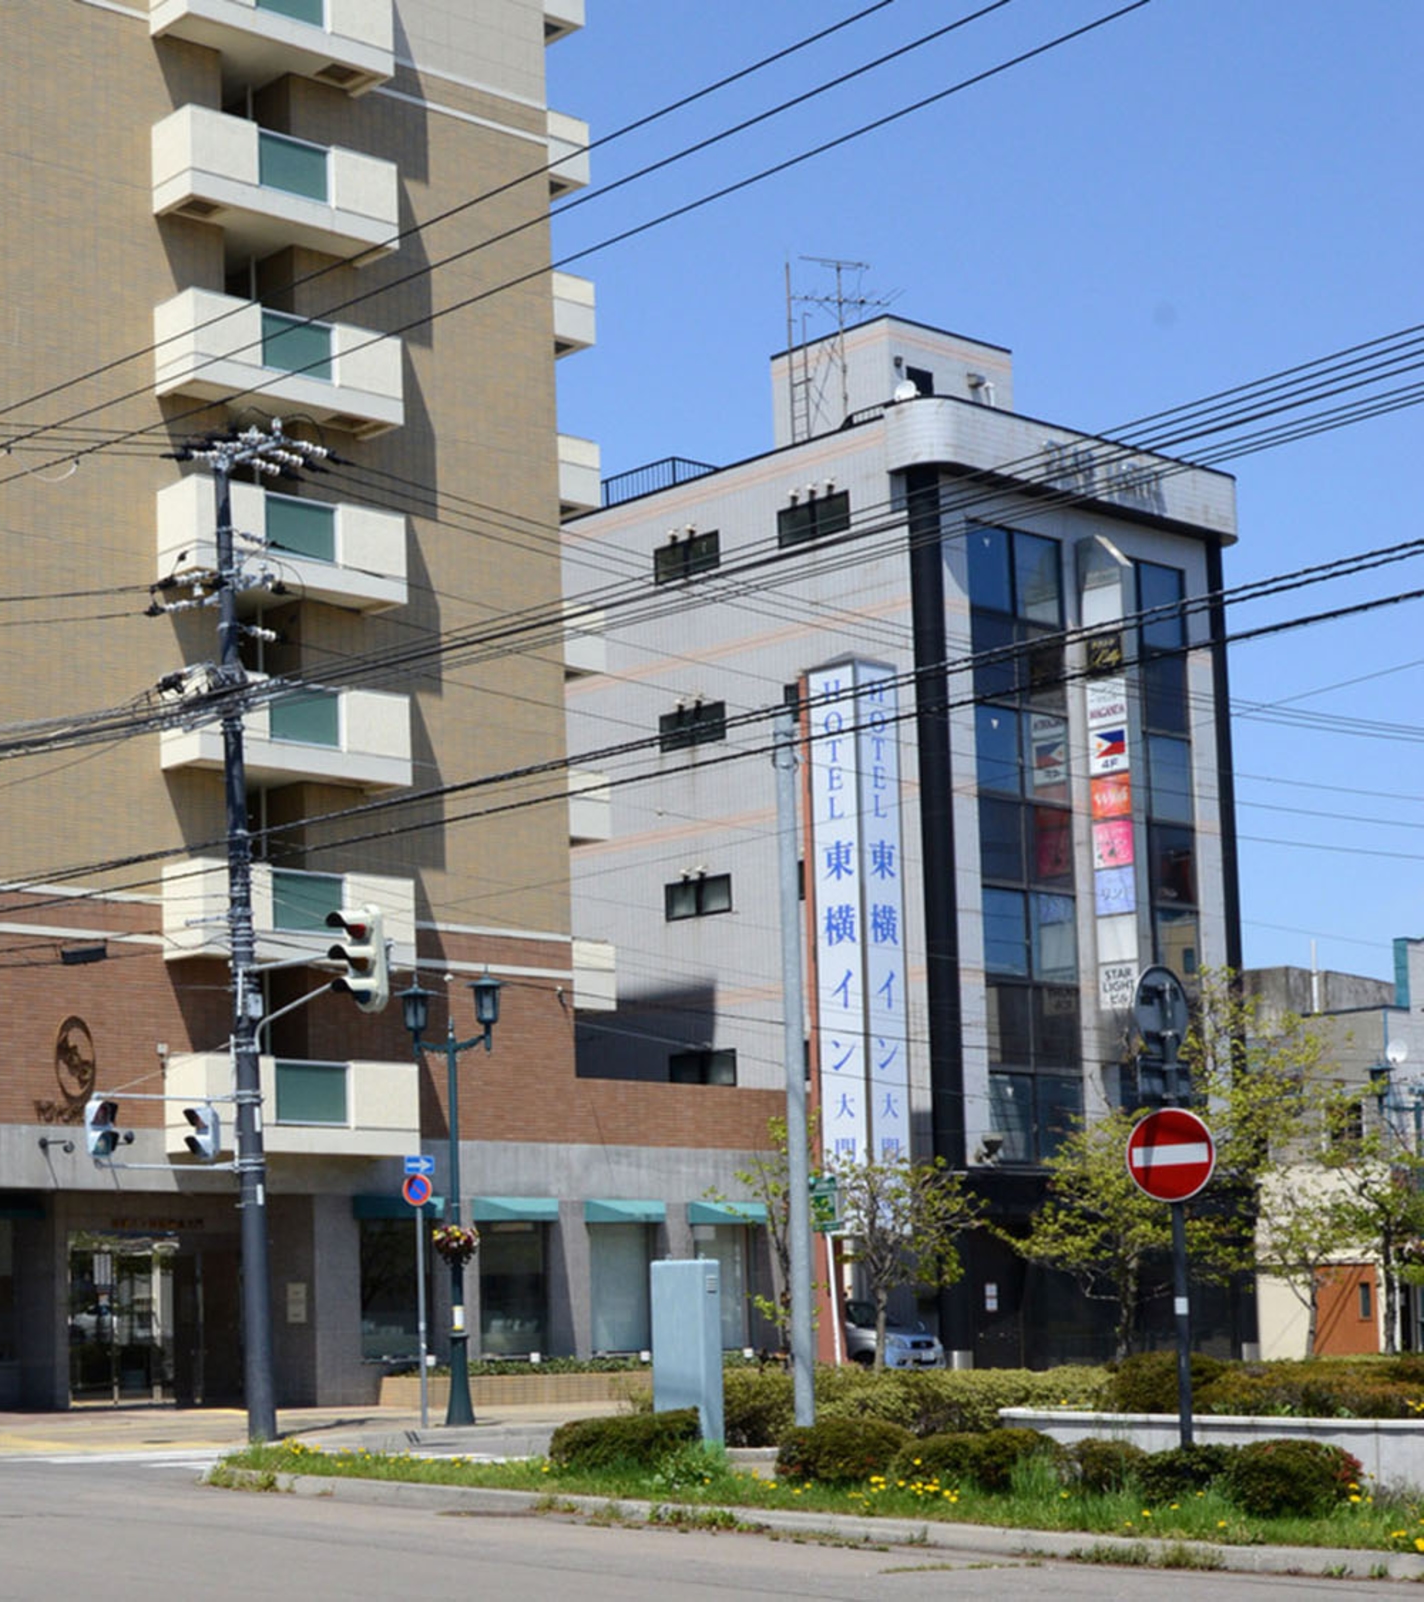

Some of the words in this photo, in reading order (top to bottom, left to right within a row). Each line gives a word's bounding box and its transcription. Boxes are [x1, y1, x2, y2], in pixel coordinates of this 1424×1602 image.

[823, 679, 844, 820] HOTEL
[869, 681, 888, 818] HOTEL
[1101, 757, 1119, 770] 4F
[824, 840, 856, 1071] 東横イン
[869, 840, 898, 1070] 東横イン
[1102, 979, 1135, 993] LIGHT
[1104, 967, 1132, 980] STAR
